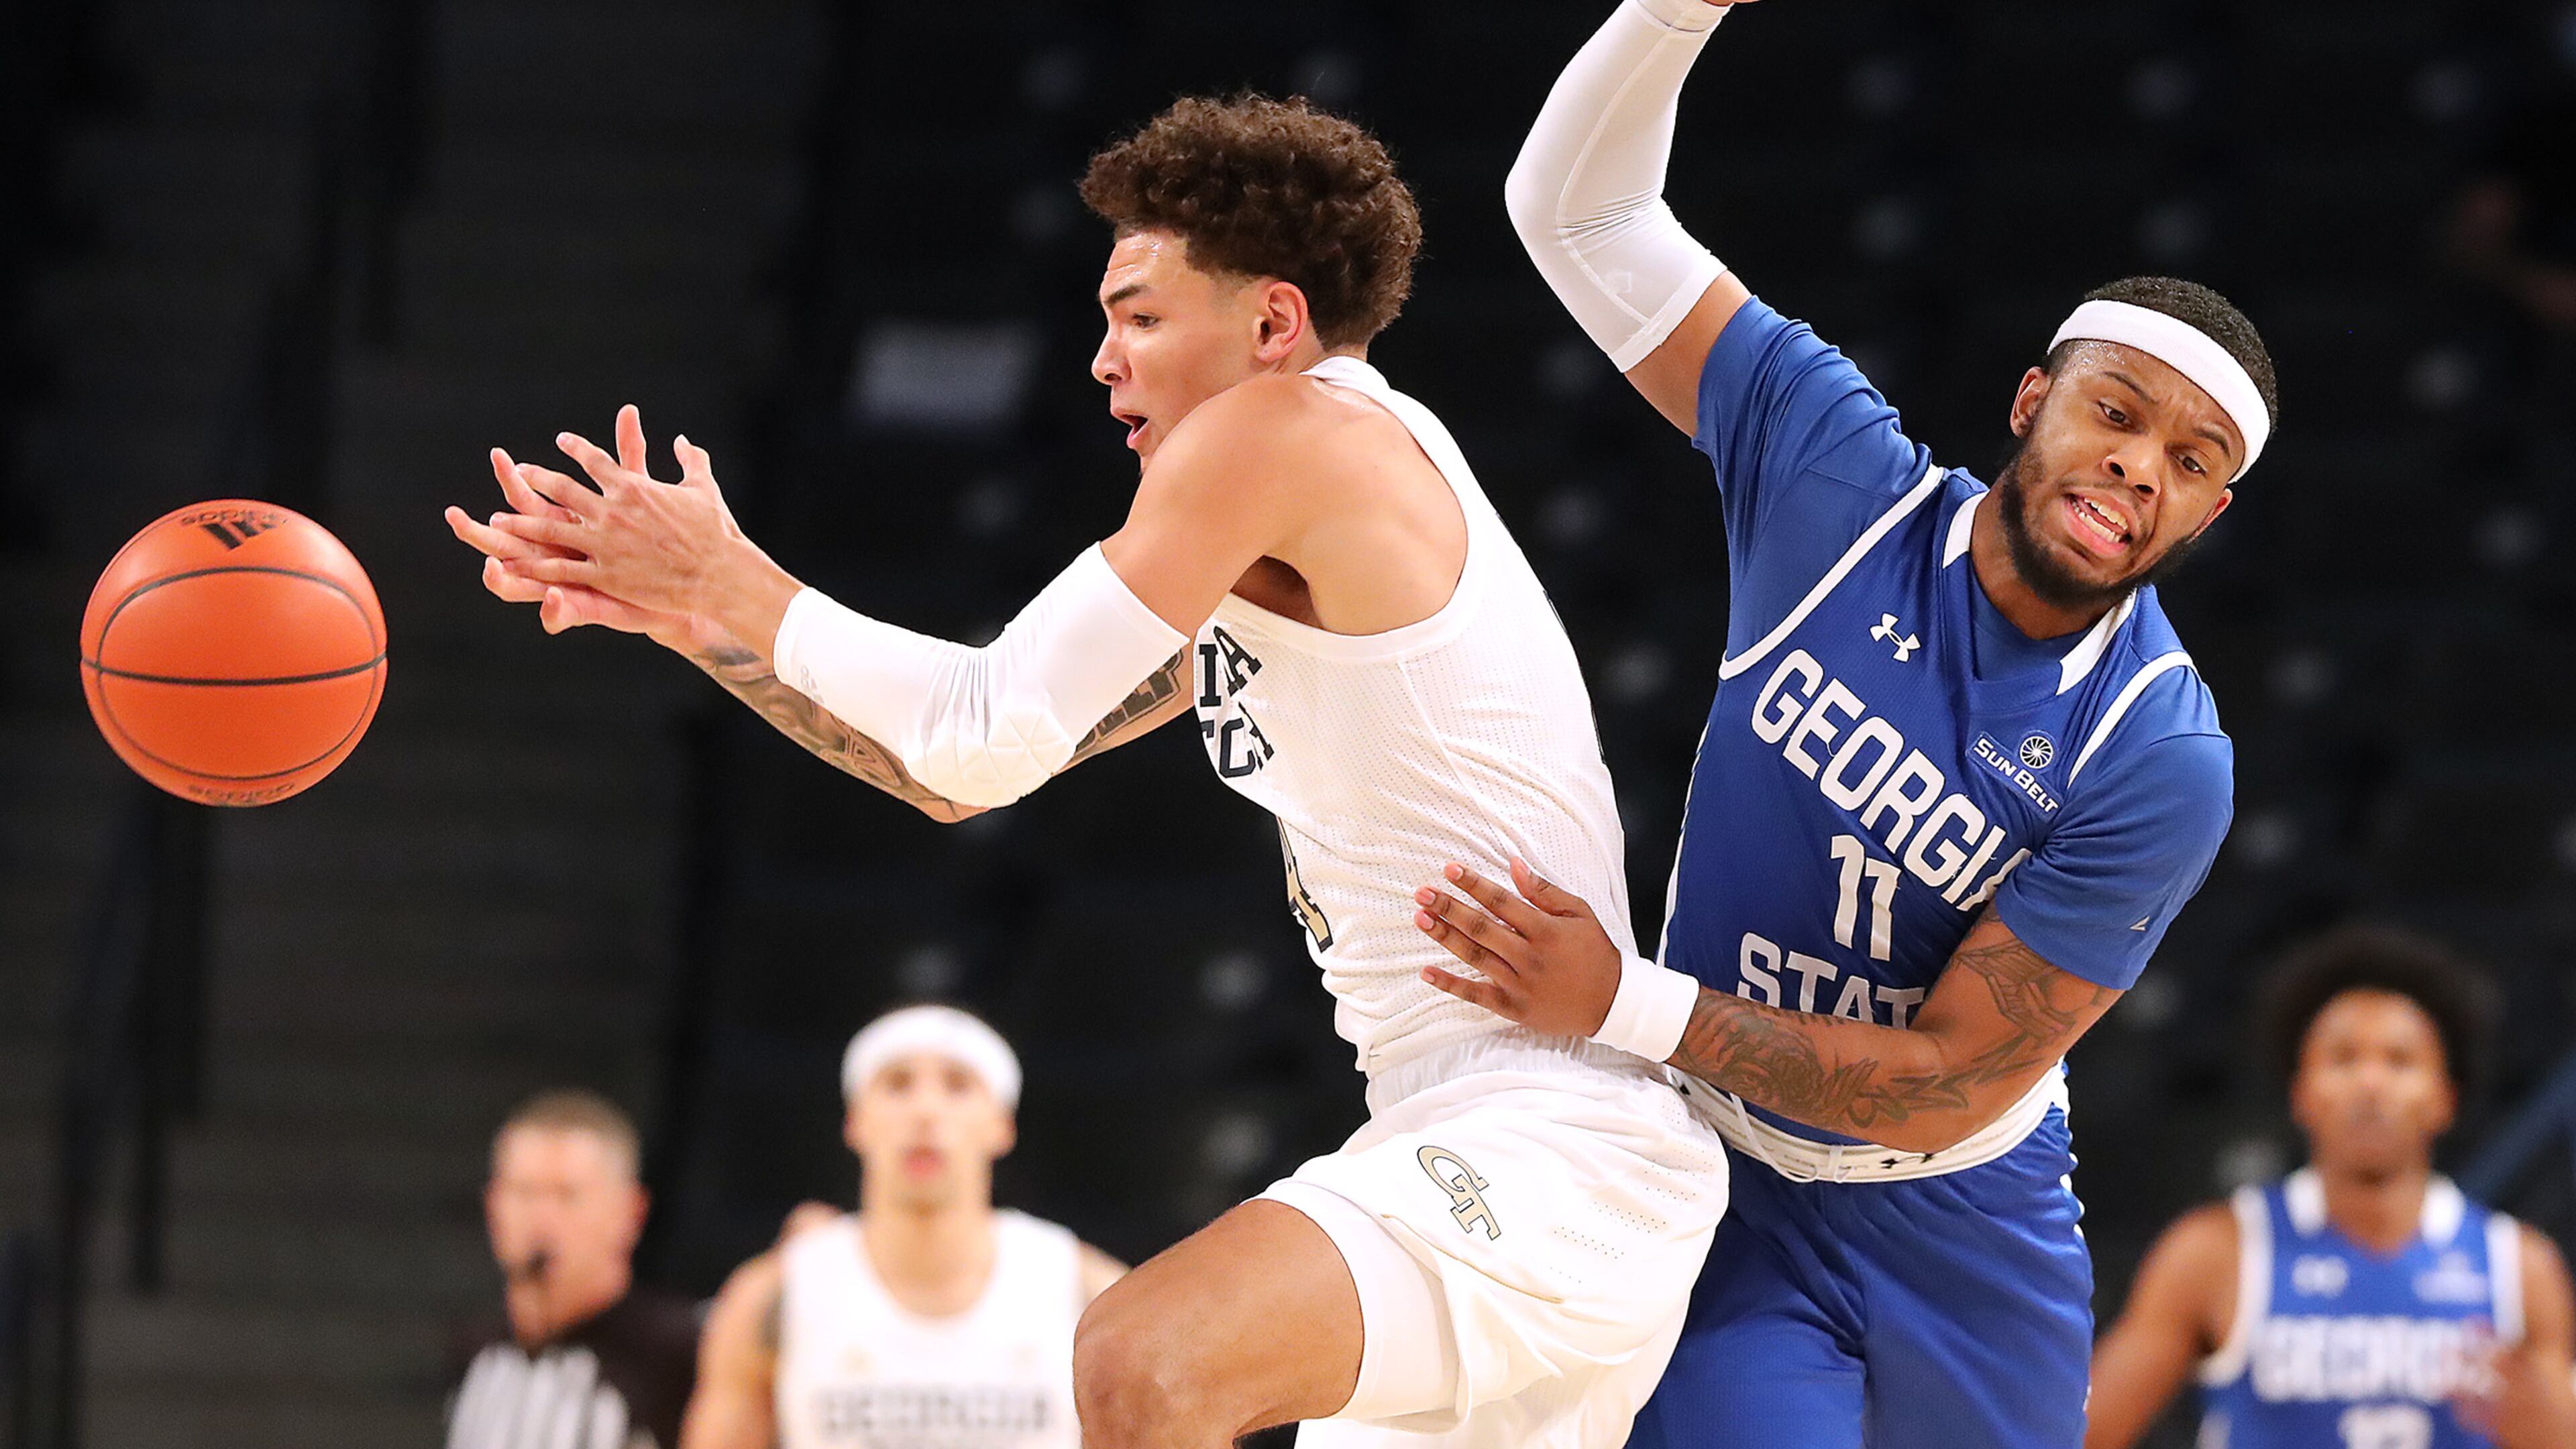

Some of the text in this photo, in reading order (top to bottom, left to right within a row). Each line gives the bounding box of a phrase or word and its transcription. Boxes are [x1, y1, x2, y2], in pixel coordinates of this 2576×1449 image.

[1974, 738, 2059, 812] SUN BELT
[1830, 834, 1901, 961] 11
[1417, 1145, 1502, 1241] GT
